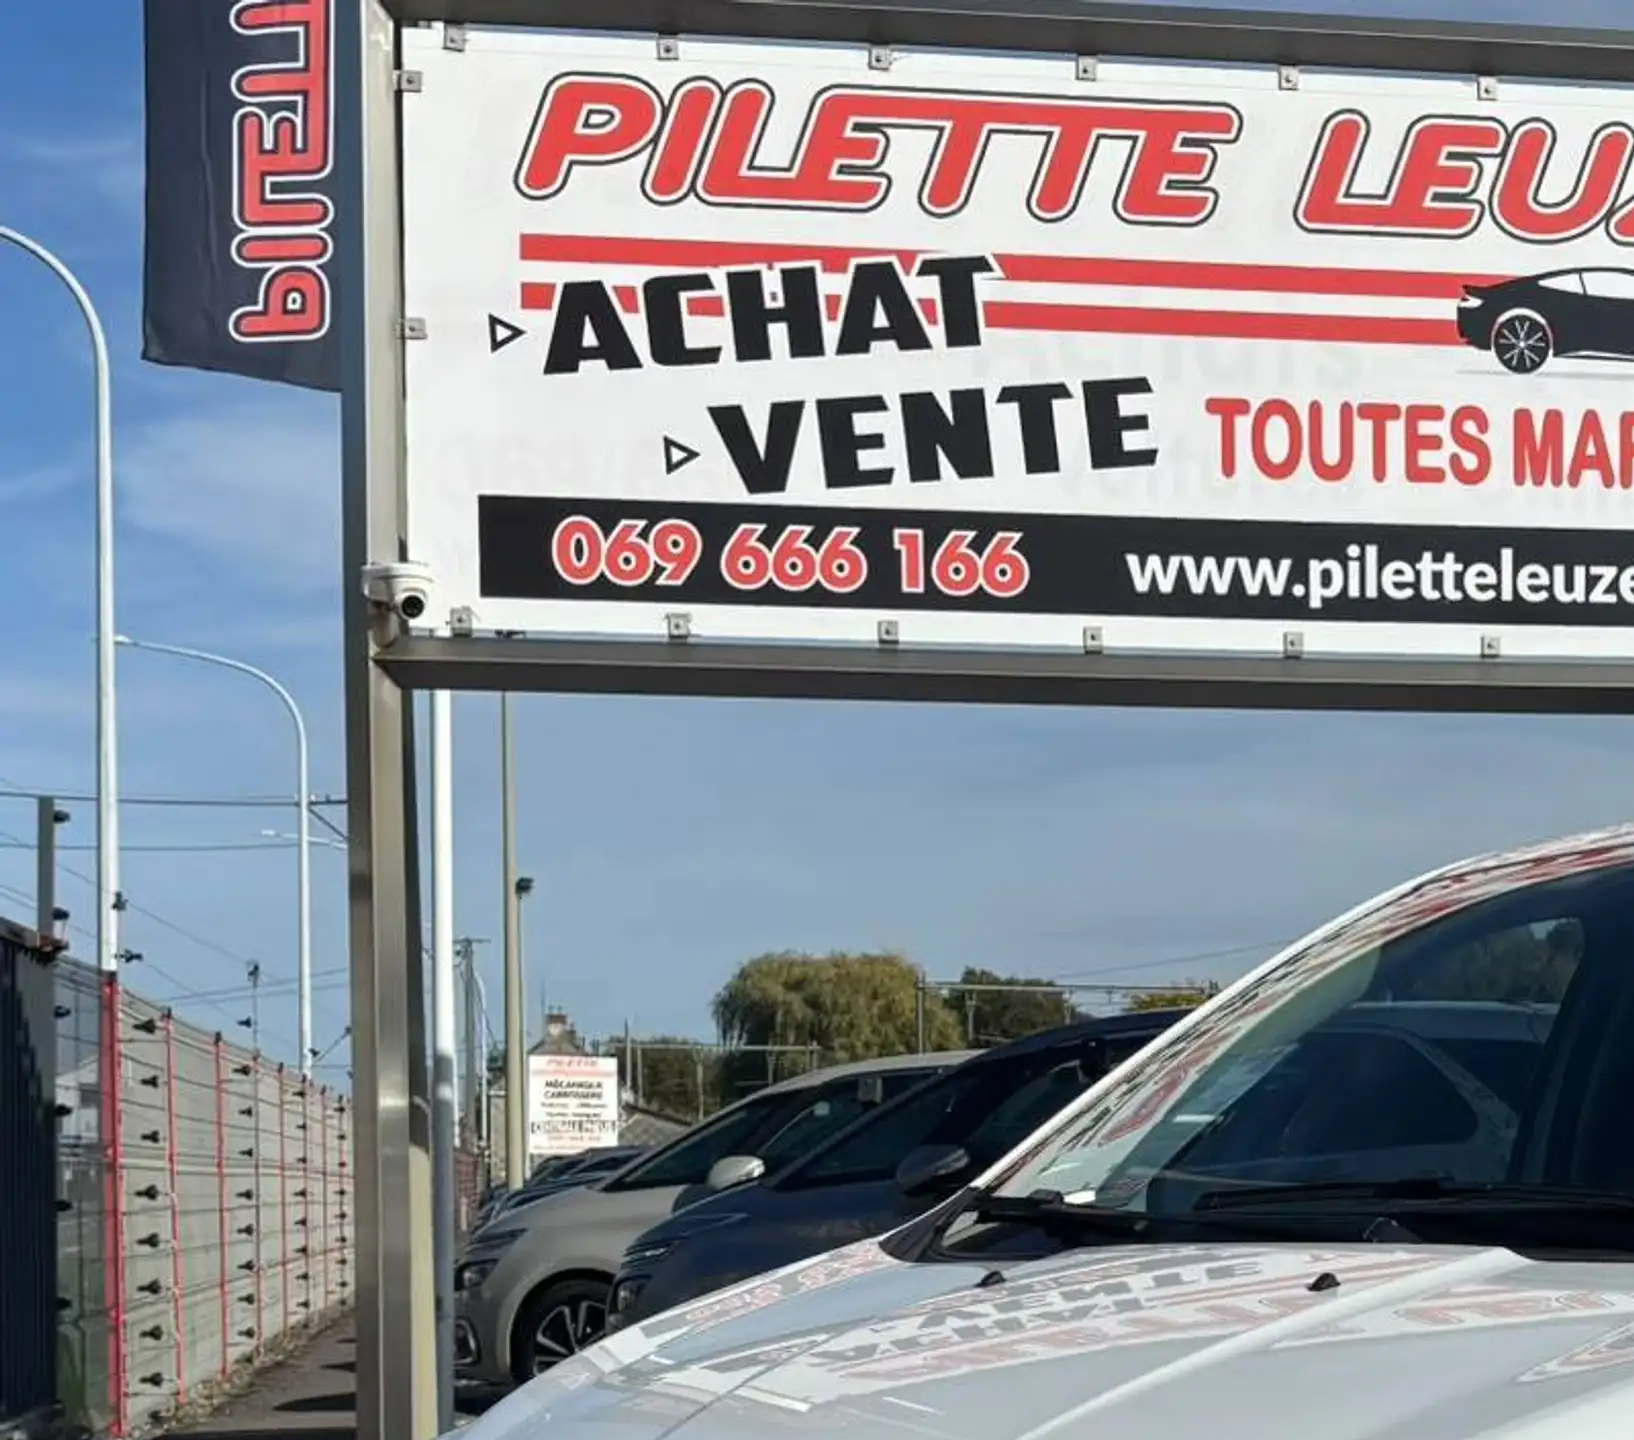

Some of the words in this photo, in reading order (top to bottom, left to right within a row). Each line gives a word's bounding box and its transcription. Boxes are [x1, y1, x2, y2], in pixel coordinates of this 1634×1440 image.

[514, 70, 1243, 227] PILETTE
[544, 254, 1000, 375] ACHAT
[708, 377, 1158, 494] VENTE
[1206, 397, 1491, 484] TOUTES
[552, 515, 702, 588] 069
[721, 525, 868, 595] 666
[893, 528, 1030, 599] 166
